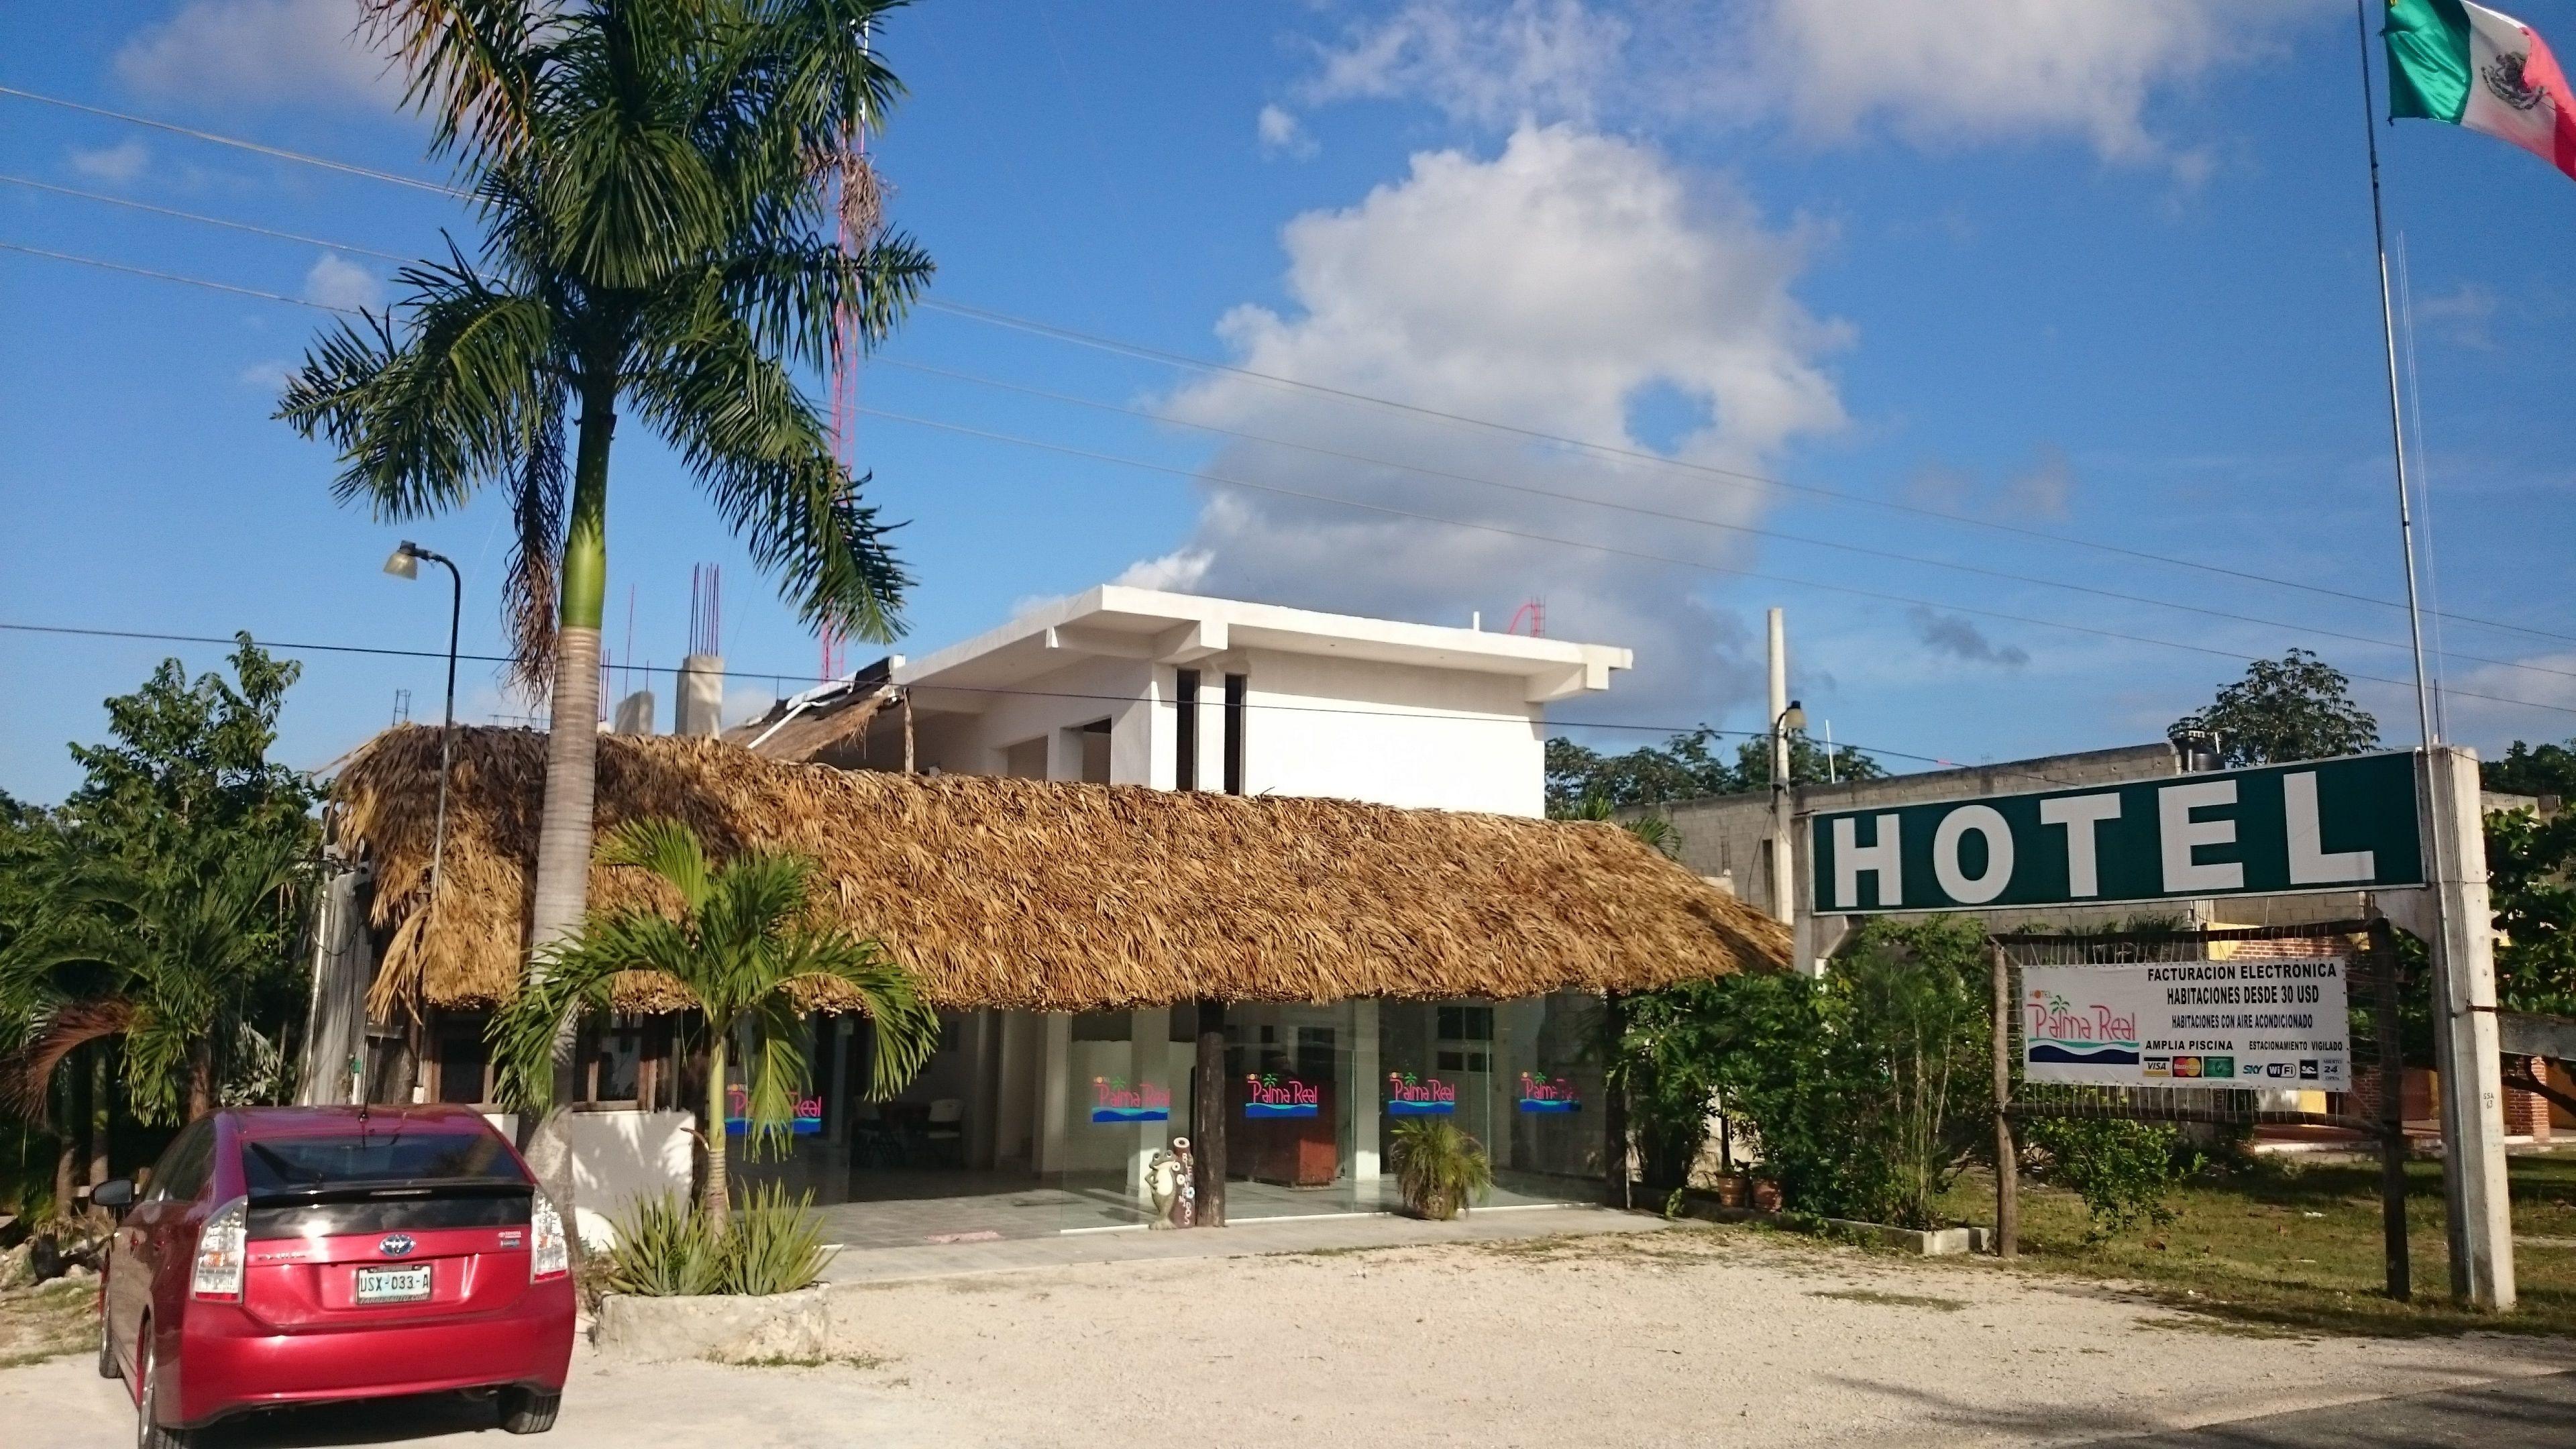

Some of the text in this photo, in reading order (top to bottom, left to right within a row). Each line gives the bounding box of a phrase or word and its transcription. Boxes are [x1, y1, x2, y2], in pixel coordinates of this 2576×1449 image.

[1833, 771, 2375, 908] HOTEL
[2148, 963, 2337, 981] FACTURACION ELECTRONICA
[2167, 985, 2319, 1004] HABITACIONES DESDE 30 USD
[2027, 1004, 2135, 1040] Palma Real
[2171, 1014, 2312, 1028] HABITACIONES CON AIRE ACONDICIONADO
[2145, 1040, 2233, 1050] AMPLIA PISCINA
[2249, 1040, 2343, 1051] ESTACIONAMIENTO VIGILADO
[2147, 1062, 2167, 1070] VISA
[2243, 1065, 2263, 1074] SKY
[1094, 1083, 1141, 1107] Palma
[1248, 1081, 1318, 1103] Palma Real
[1390, 1079, 1454, 1101] Palma Real
[360, 1275, 429, 1292] USX-033-A
